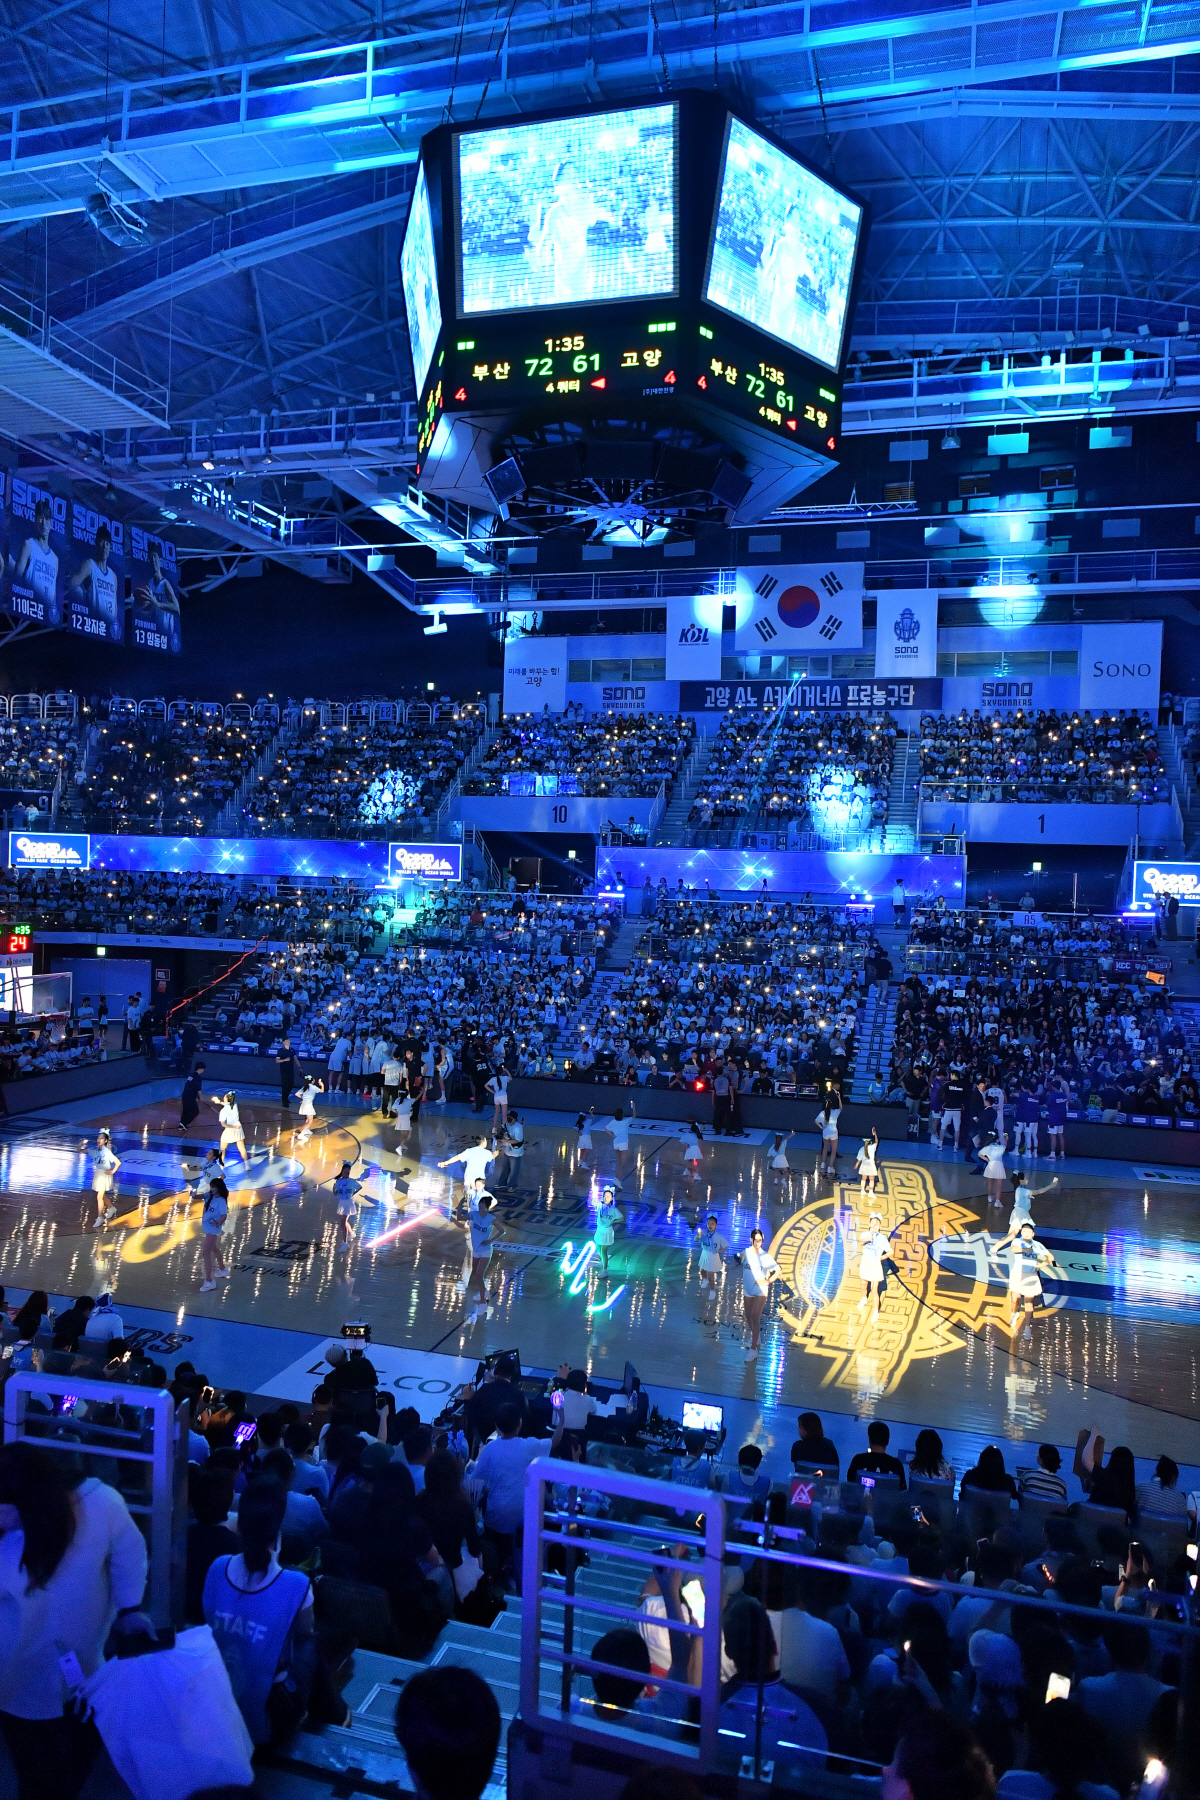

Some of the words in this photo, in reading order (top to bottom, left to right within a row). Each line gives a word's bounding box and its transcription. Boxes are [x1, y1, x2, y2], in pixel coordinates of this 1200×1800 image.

[544, 335, 585, 353] 1:35
[524, 357, 554, 377] 72
[572, 353, 601, 373] 61
[620, 349, 662, 368] 고양
[472, 362, 511, 381] 부산
[664, 369, 677, 384] 4
[710, 357, 738, 386] 부산
[758, 362, 785, 387] 1:35
[545, 382, 555, 394] 4
[556, 379, 581, 394] 쿼터
[697, 375, 708, 390] 4
[454, 387, 467, 401] 4
[745, 373, 766, 399] 72
[775, 390, 794, 412] 61
[765, 407, 782, 426] 쿼터
[803, 405, 829, 429] 고양
[827, 436, 836, 450] 4
[71, 614, 82, 631] 12
[83, 617, 107, 637] 강지훈
[134, 629, 146, 644] 13
[678, 627, 710, 643] KBL
[894, 646, 919, 655] SONO
[508, 667, 528, 677] 미래를
[528, 667, 550, 677] 바꾸는
[524, 676, 544, 688] 고양
[982, 682, 1033, 697] SONO
[602, 686, 646, 701] SONO
[704, 686, 731, 709] 고양
[734, 685, 759, 708] 소노
[762, 685, 842, 709] 스카이거너스
[846, 684, 916, 708] 프로농구단
[982, 698, 1033, 707] SKYGUNNERS
[38, 795, 49, 812] 9
[552, 805, 568, 823] 10
[1037, 813, 1045, 834] 1
[1024, 914, 1036, 926] A5
[15, 925, 31, 935] 1:35
[10, 935, 27, 952] 24
[1115, 961, 1131, 970] KCC
